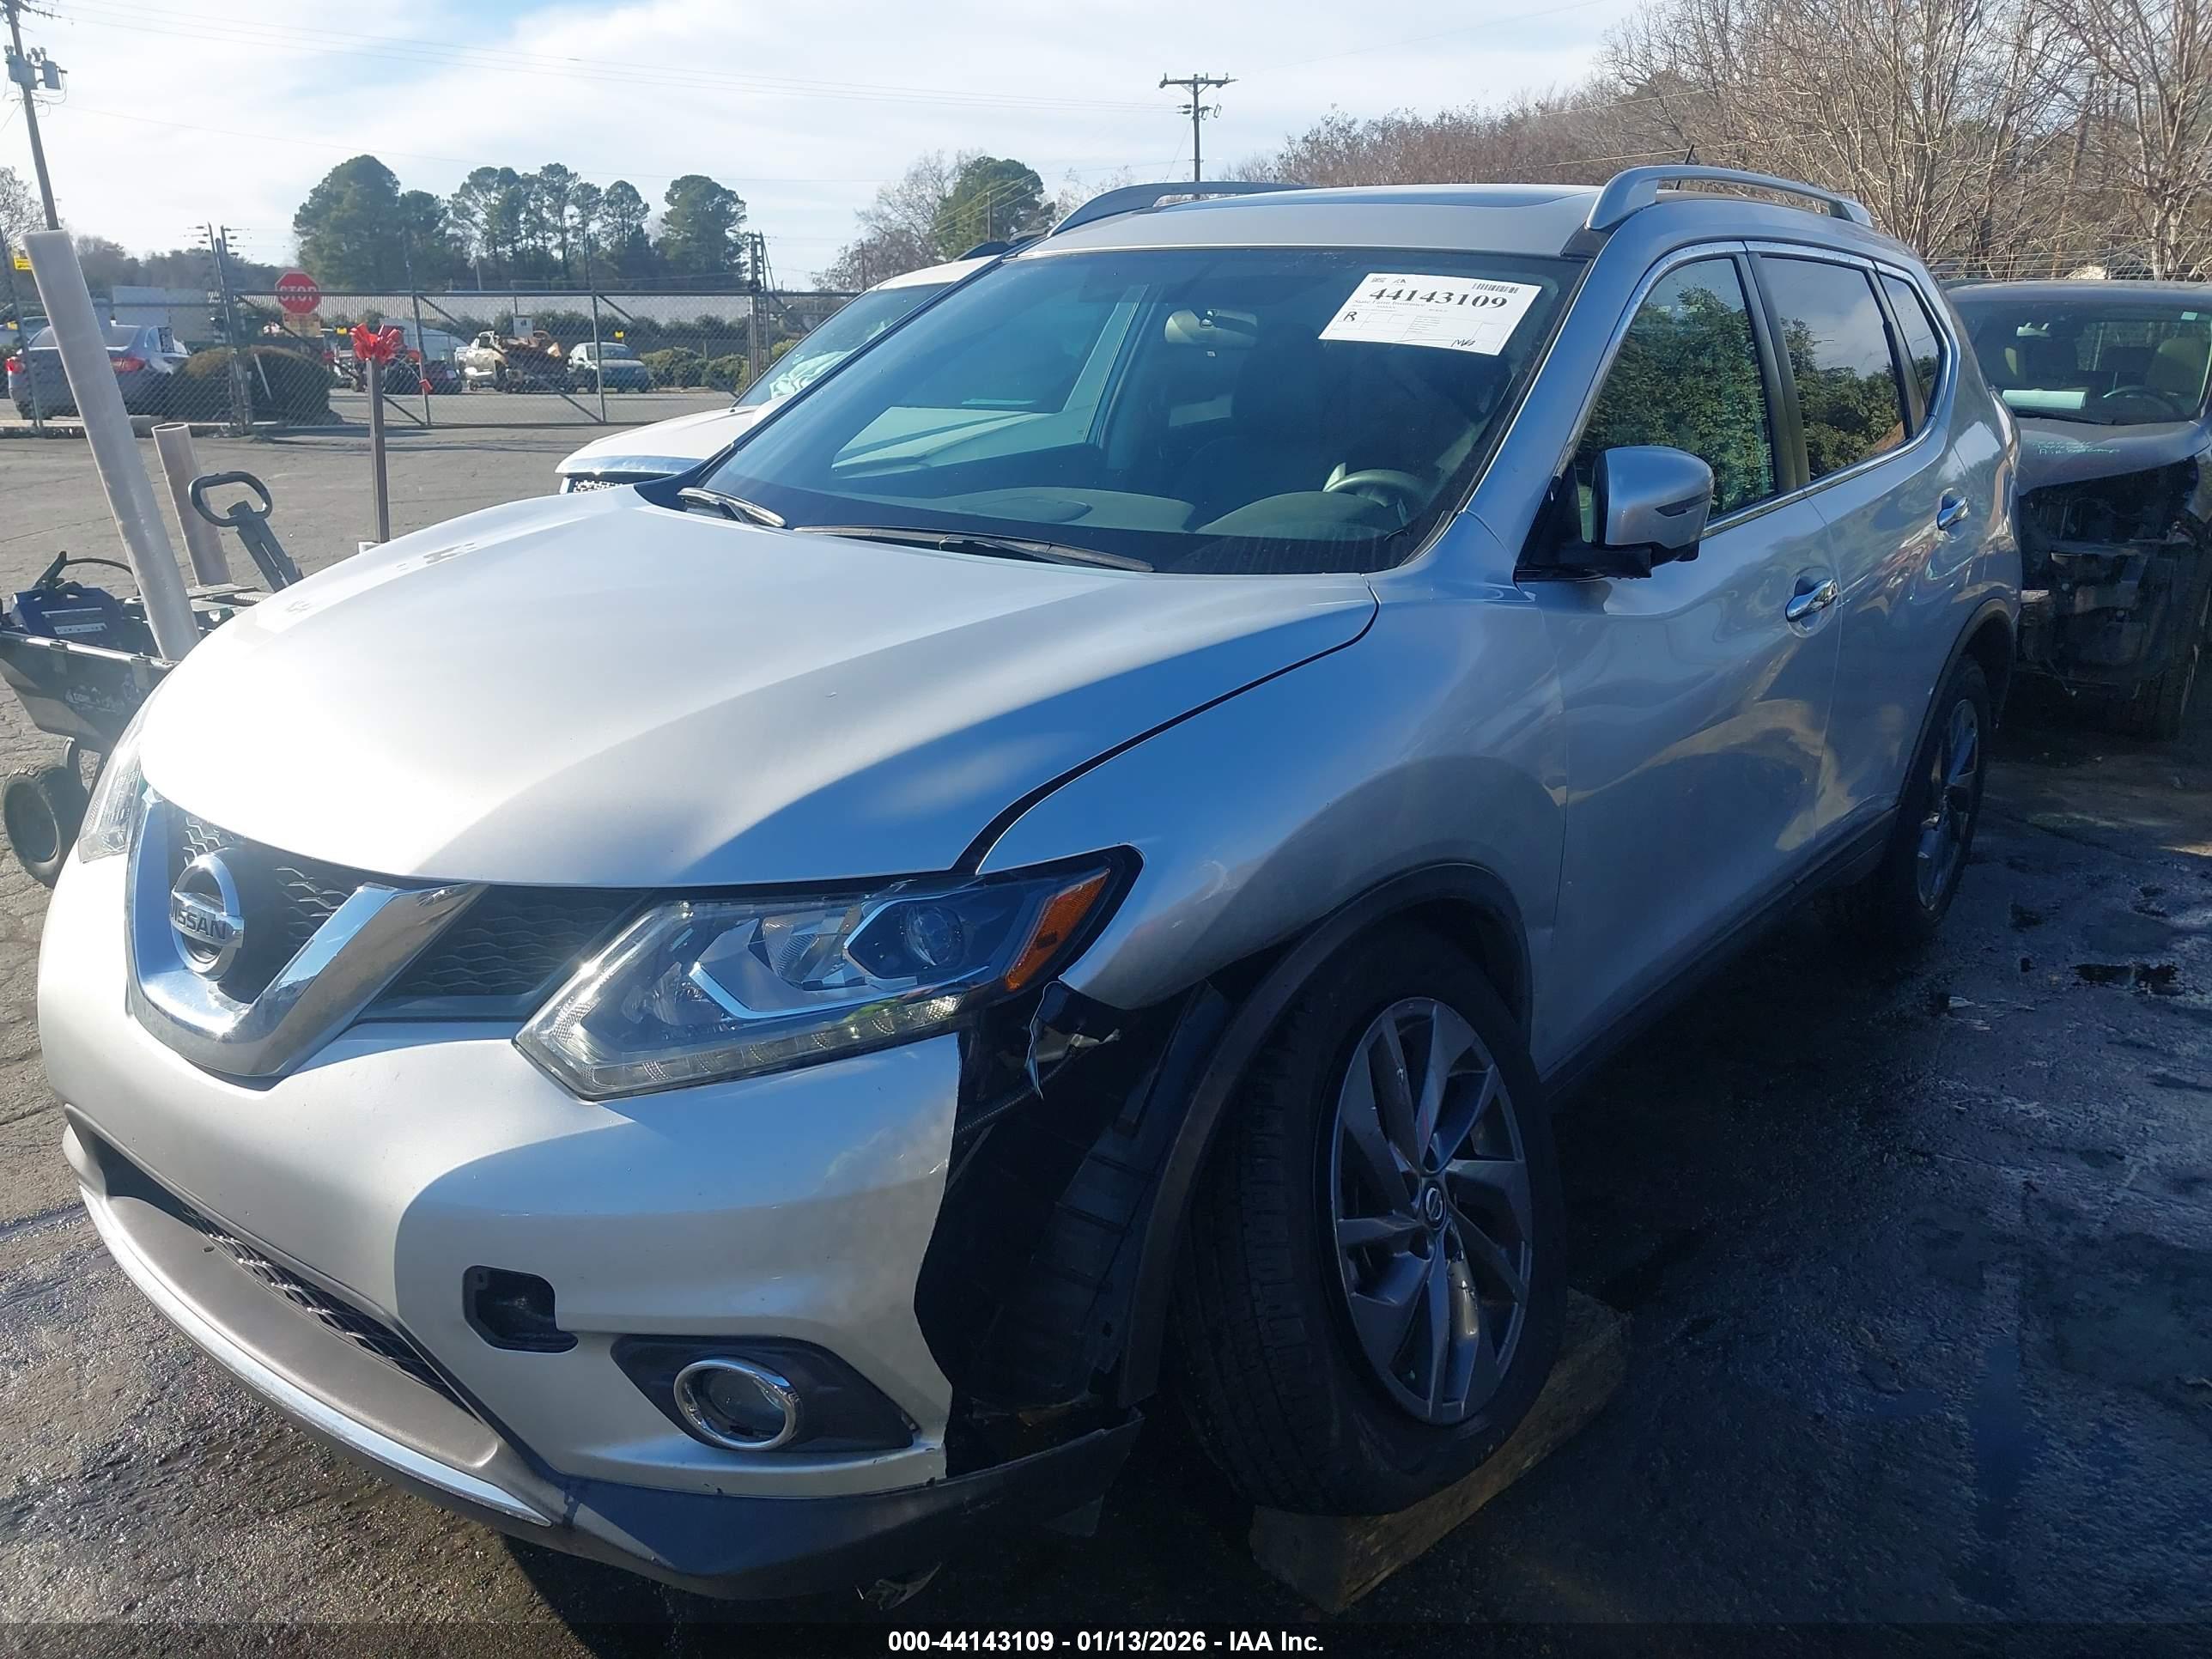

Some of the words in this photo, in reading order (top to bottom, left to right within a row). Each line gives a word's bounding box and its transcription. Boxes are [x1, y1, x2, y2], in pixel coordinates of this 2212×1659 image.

[279, 285, 317, 302] STOP
[1369, 288, 1509, 309] 44143109
[1343, 311, 1358, 322] R
[171, 899, 227, 940] NISSAN
